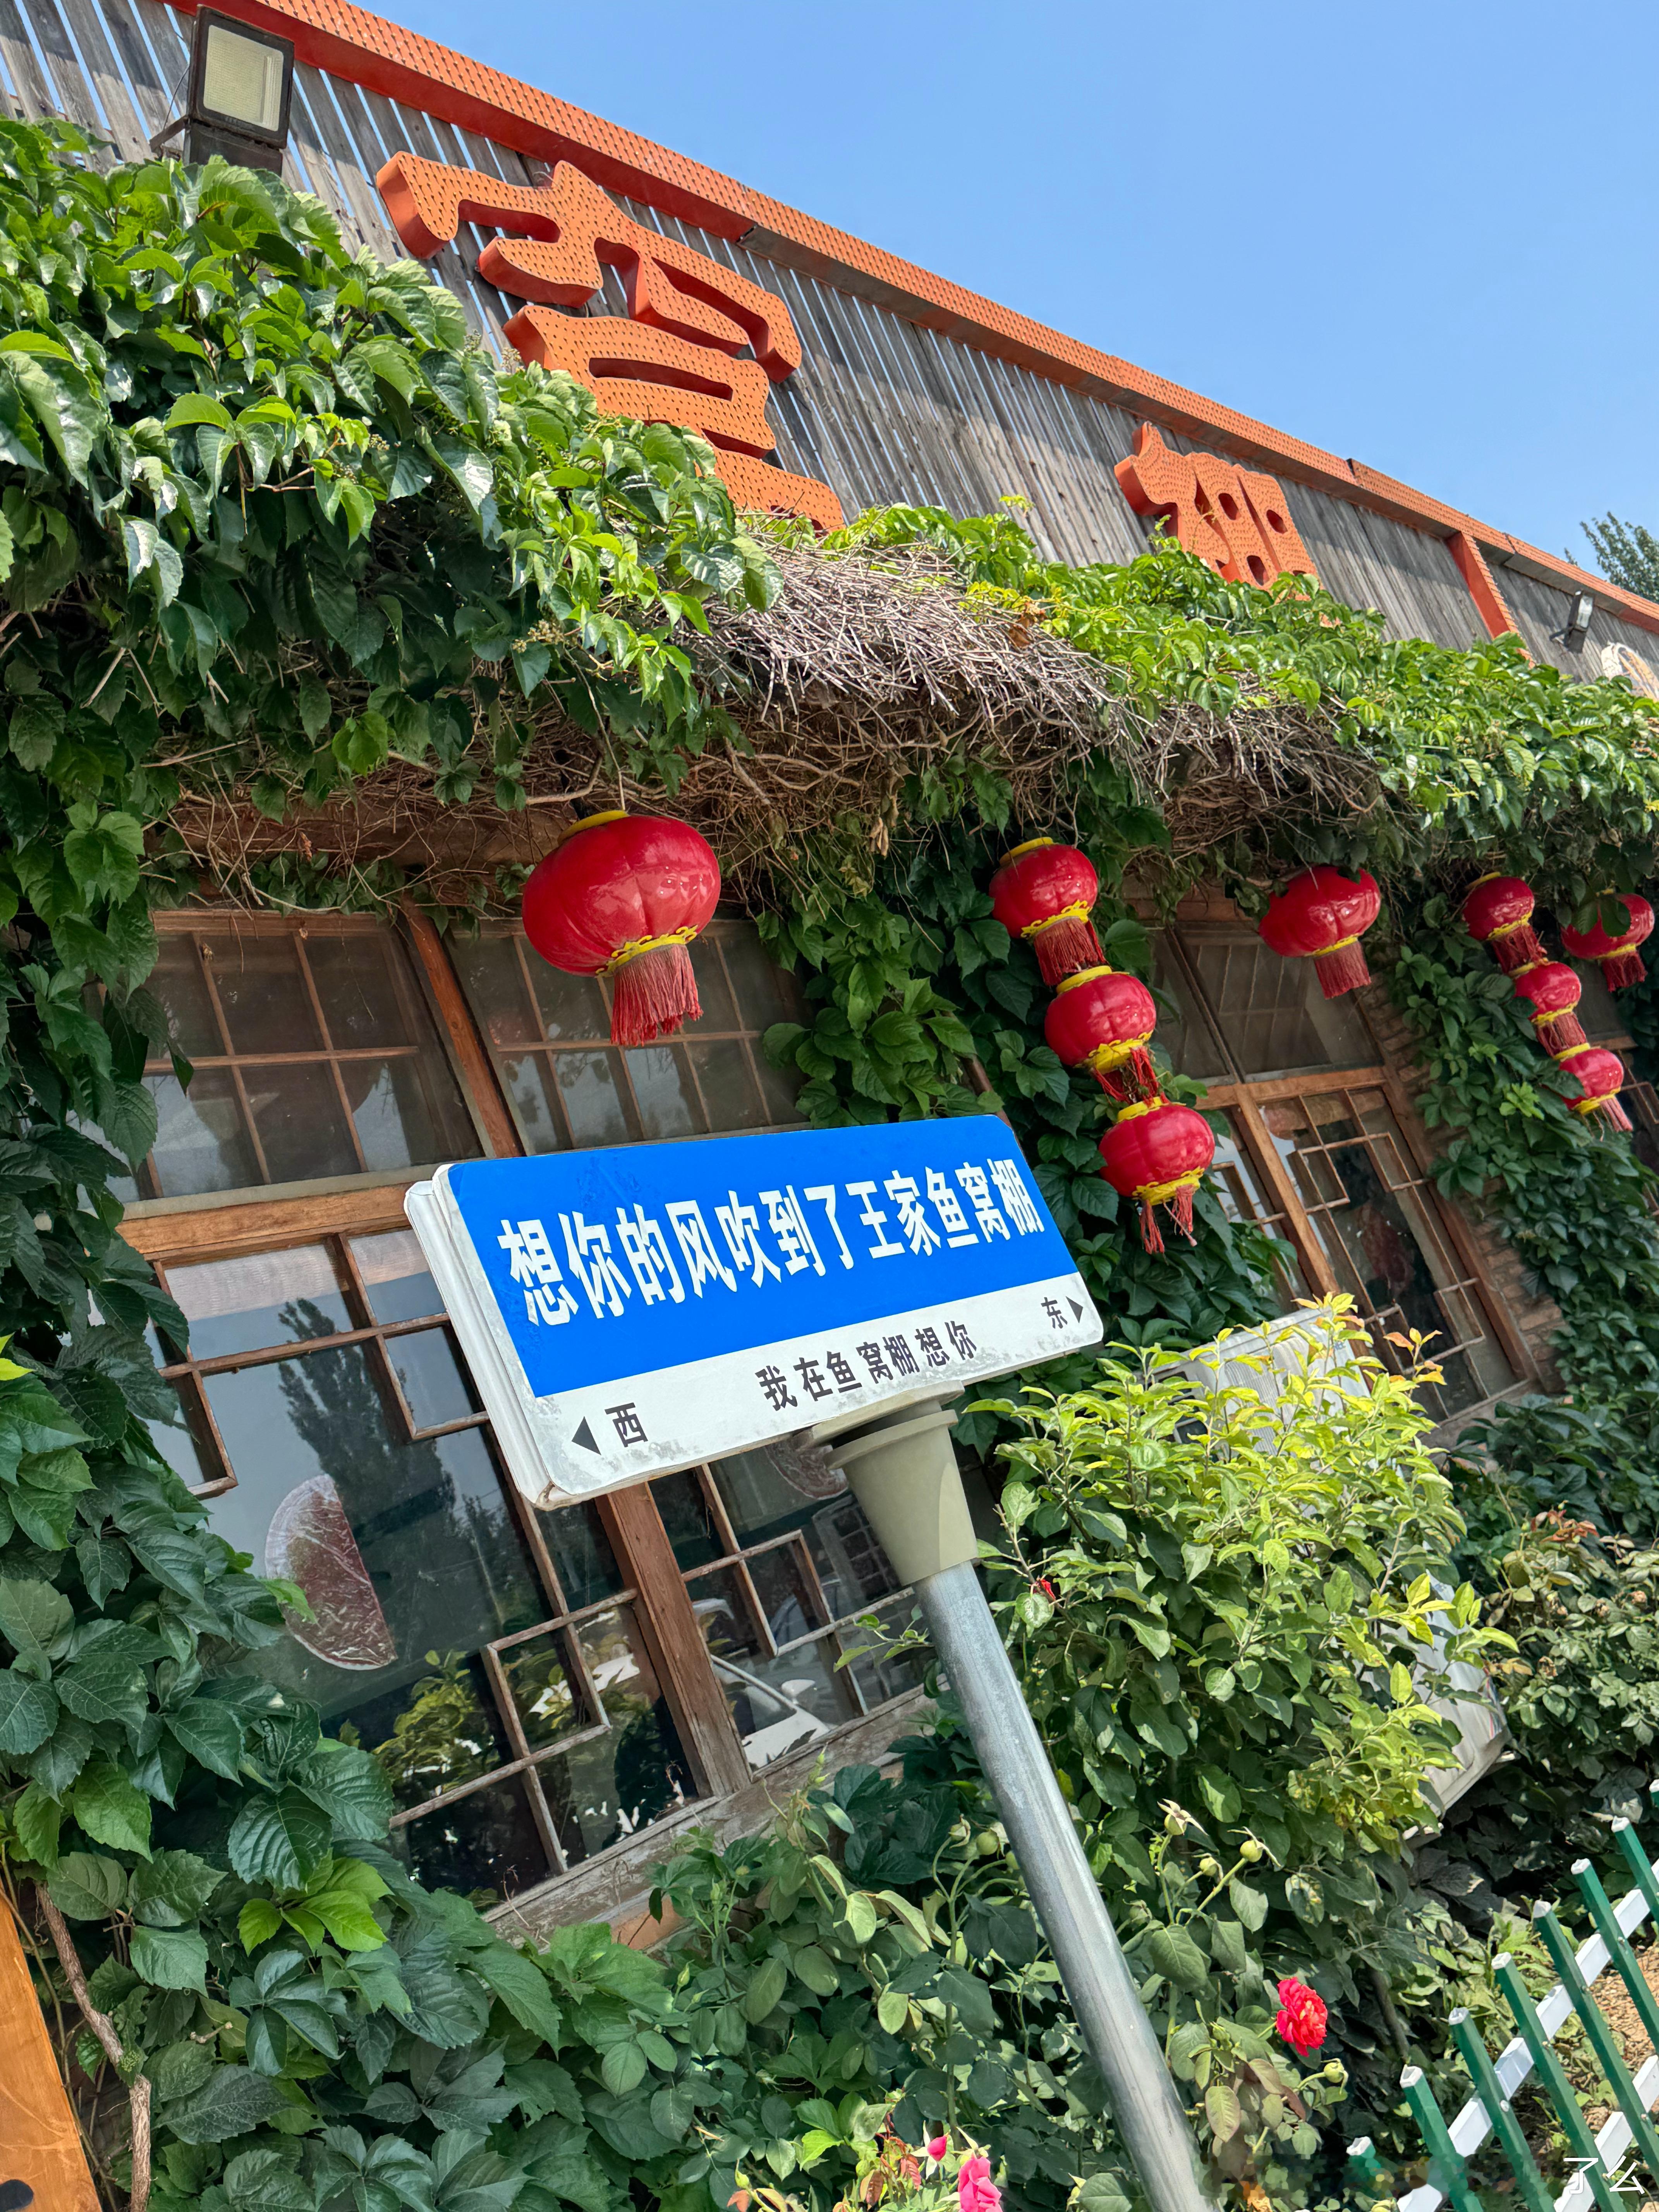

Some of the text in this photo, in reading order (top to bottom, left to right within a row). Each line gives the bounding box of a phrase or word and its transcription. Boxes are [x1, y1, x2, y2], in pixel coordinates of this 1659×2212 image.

[497, 1159, 1045, 1326] 想你的风吹到了王家鱼窝棚
[1041, 1297, 1068, 1330] 东
[755, 1321, 978, 1412] 我在鱼窝棚想你
[605, 1402, 649, 1448] 西
